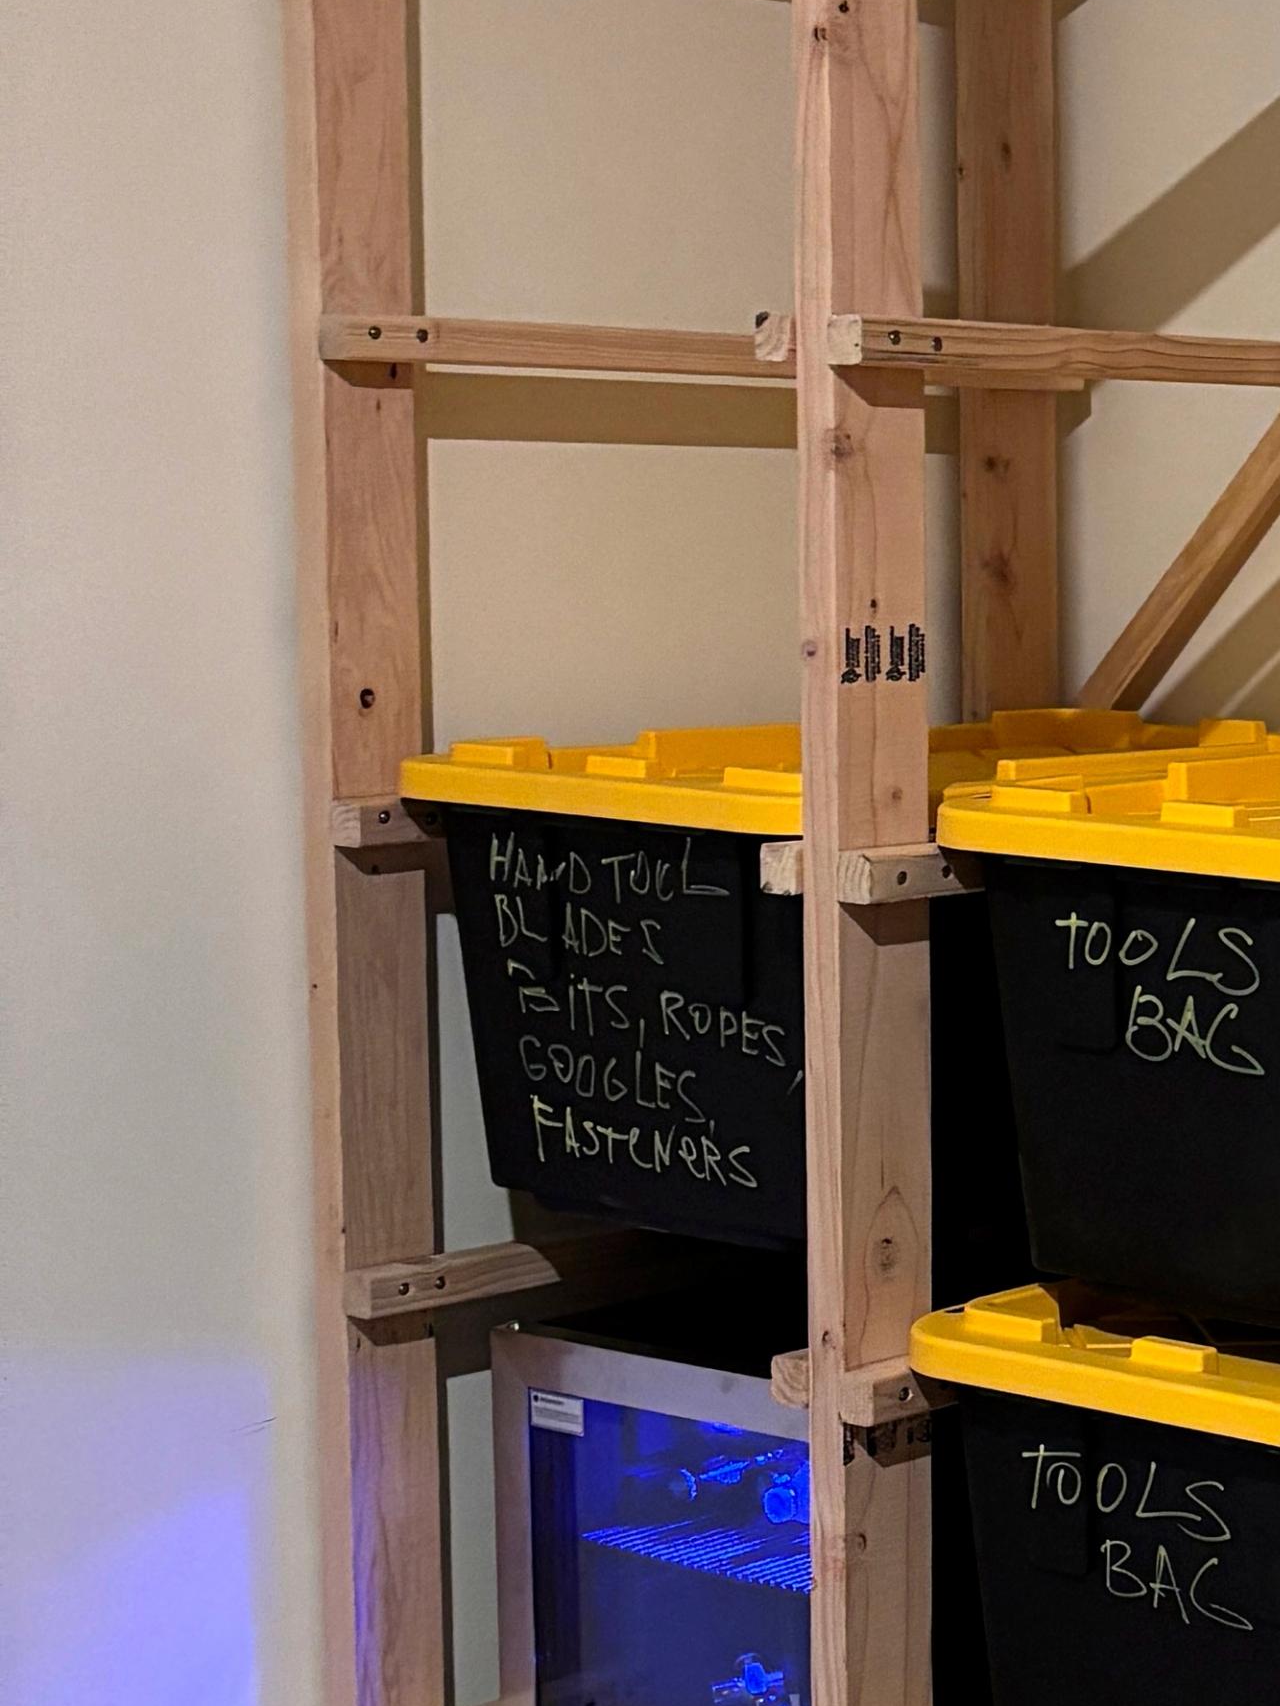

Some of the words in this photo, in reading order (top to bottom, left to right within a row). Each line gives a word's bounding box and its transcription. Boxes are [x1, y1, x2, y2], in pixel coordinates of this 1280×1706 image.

[494, 894, 664, 964] BLADES
[1055, 911, 1260, 996] TOOLS
[1022, 1444, 1231, 1541] TOOLS
